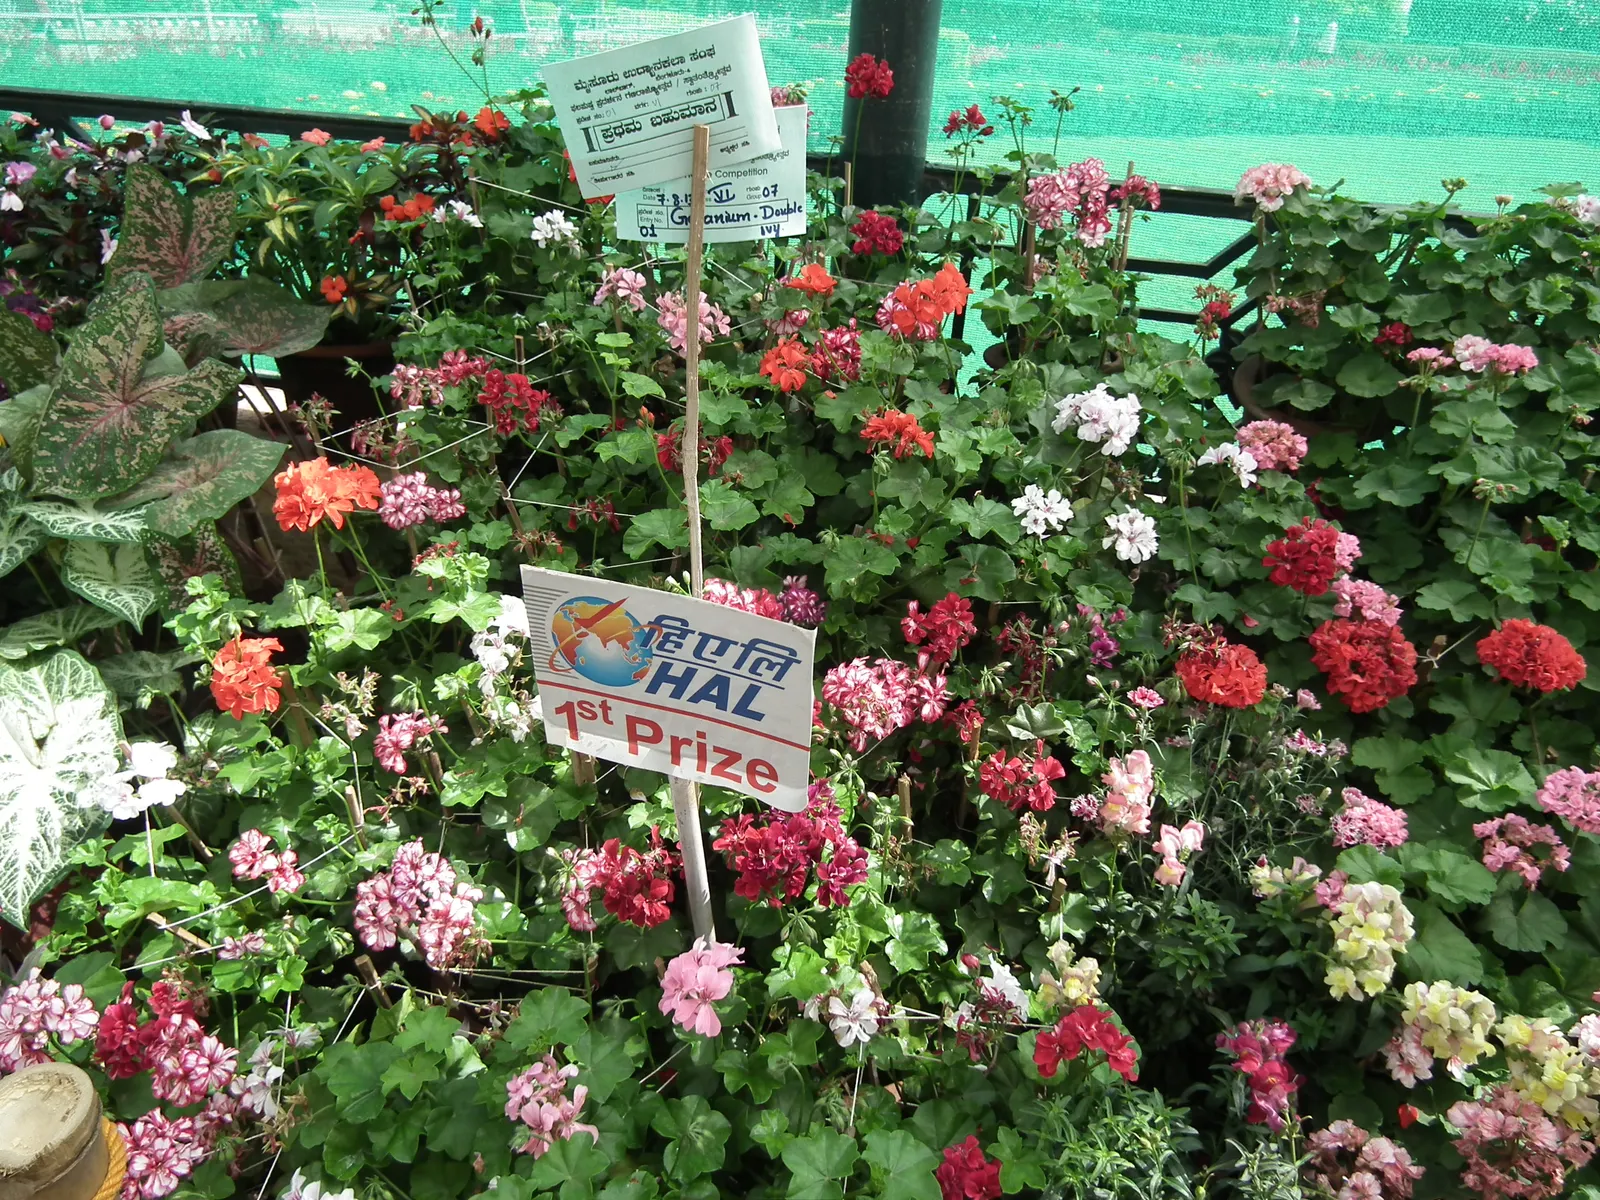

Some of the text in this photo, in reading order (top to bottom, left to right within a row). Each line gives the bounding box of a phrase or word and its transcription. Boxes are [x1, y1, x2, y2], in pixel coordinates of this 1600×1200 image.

[574, 70, 620, 94] ಮೈಸೂರು
[689, 44, 716, 62] ಸಂಘ
[601, 118, 642, 143] ಪ್ರಥಮ
[650, 99, 718, 127] ಬಹುಮಾನ
[715, 168, 768, 179] Competition
[746, 193, 762, 201] Group
[762, 183, 778, 198] 07
[640, 217, 653, 225] Entry
[671, 206, 750, 226] Ganium
[759, 202, 803, 221] Double
[639, 224, 657, 237] 01
[644, 661, 767, 722] HAL
[555, 699, 779, 794] 1st Prize
